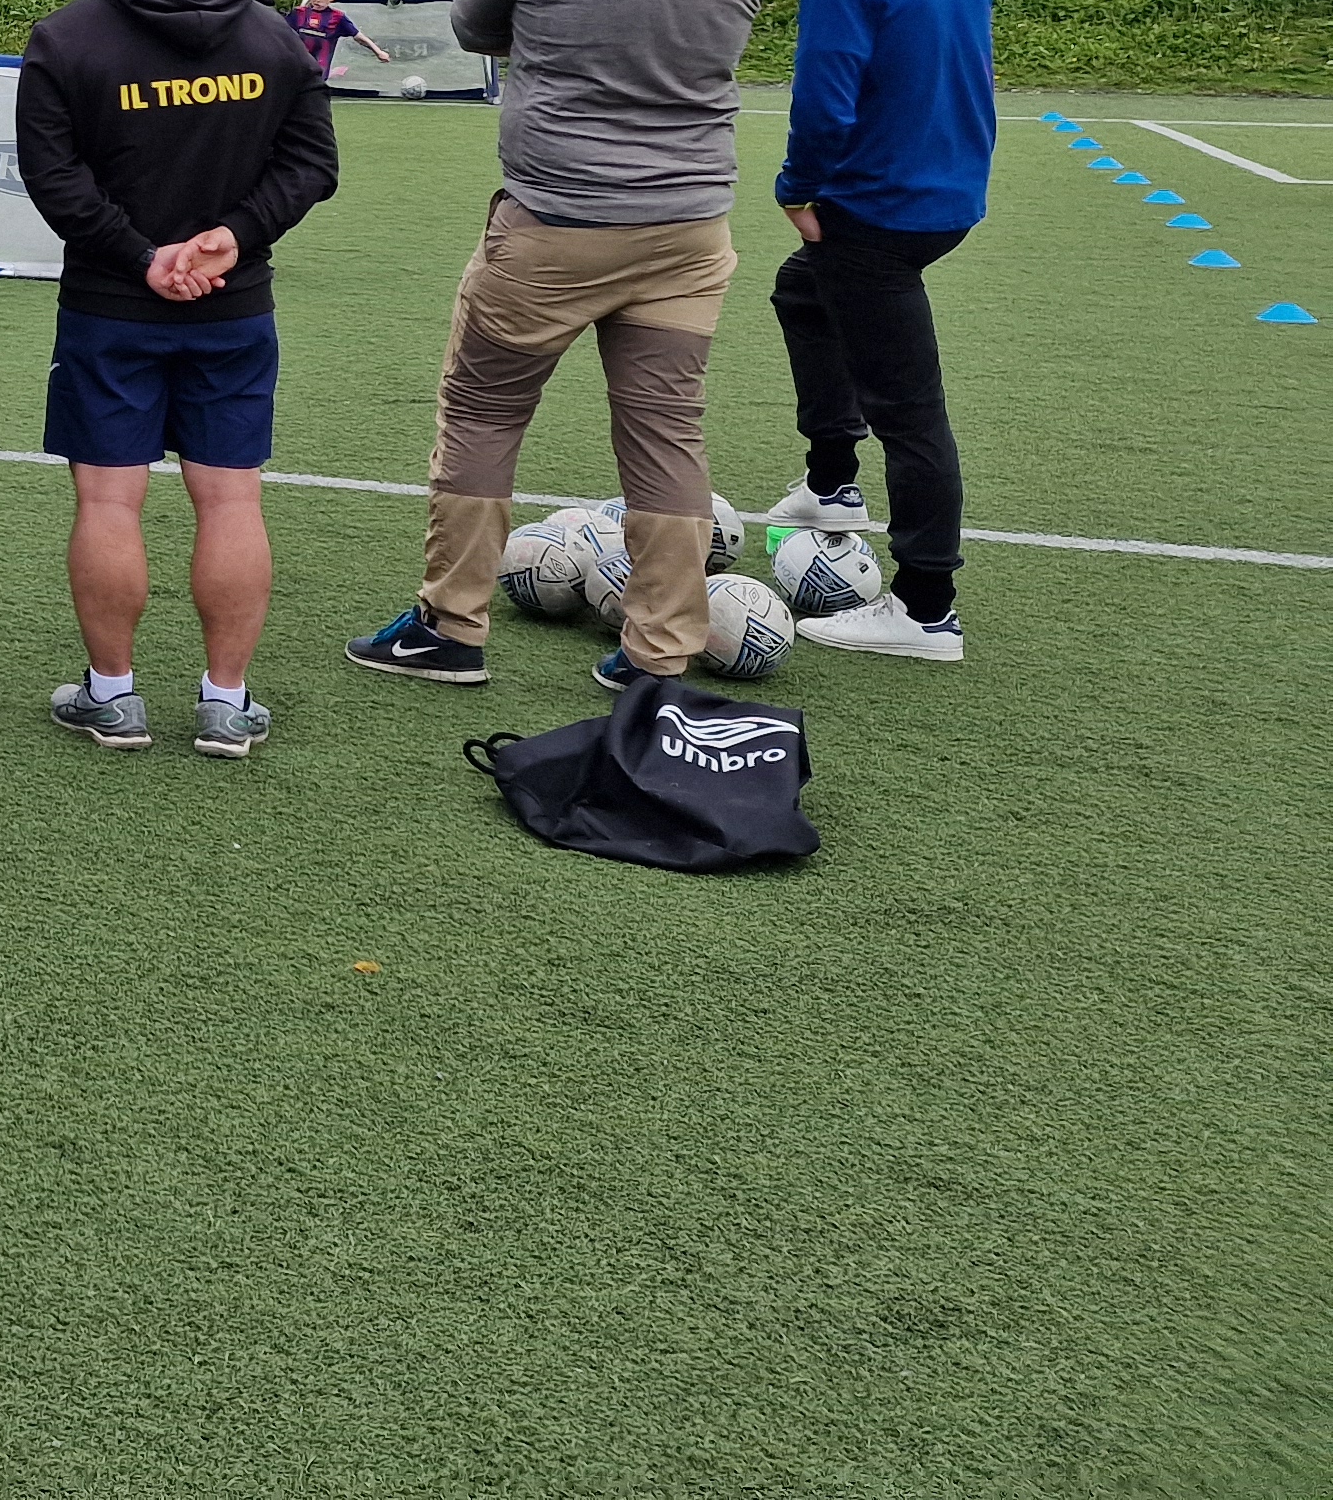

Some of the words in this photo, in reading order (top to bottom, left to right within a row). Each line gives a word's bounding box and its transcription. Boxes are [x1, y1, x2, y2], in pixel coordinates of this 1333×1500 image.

[119, 83, 149, 111] IL
[151, 72, 264, 107] TROND
[661, 734, 788, 773] umbro
